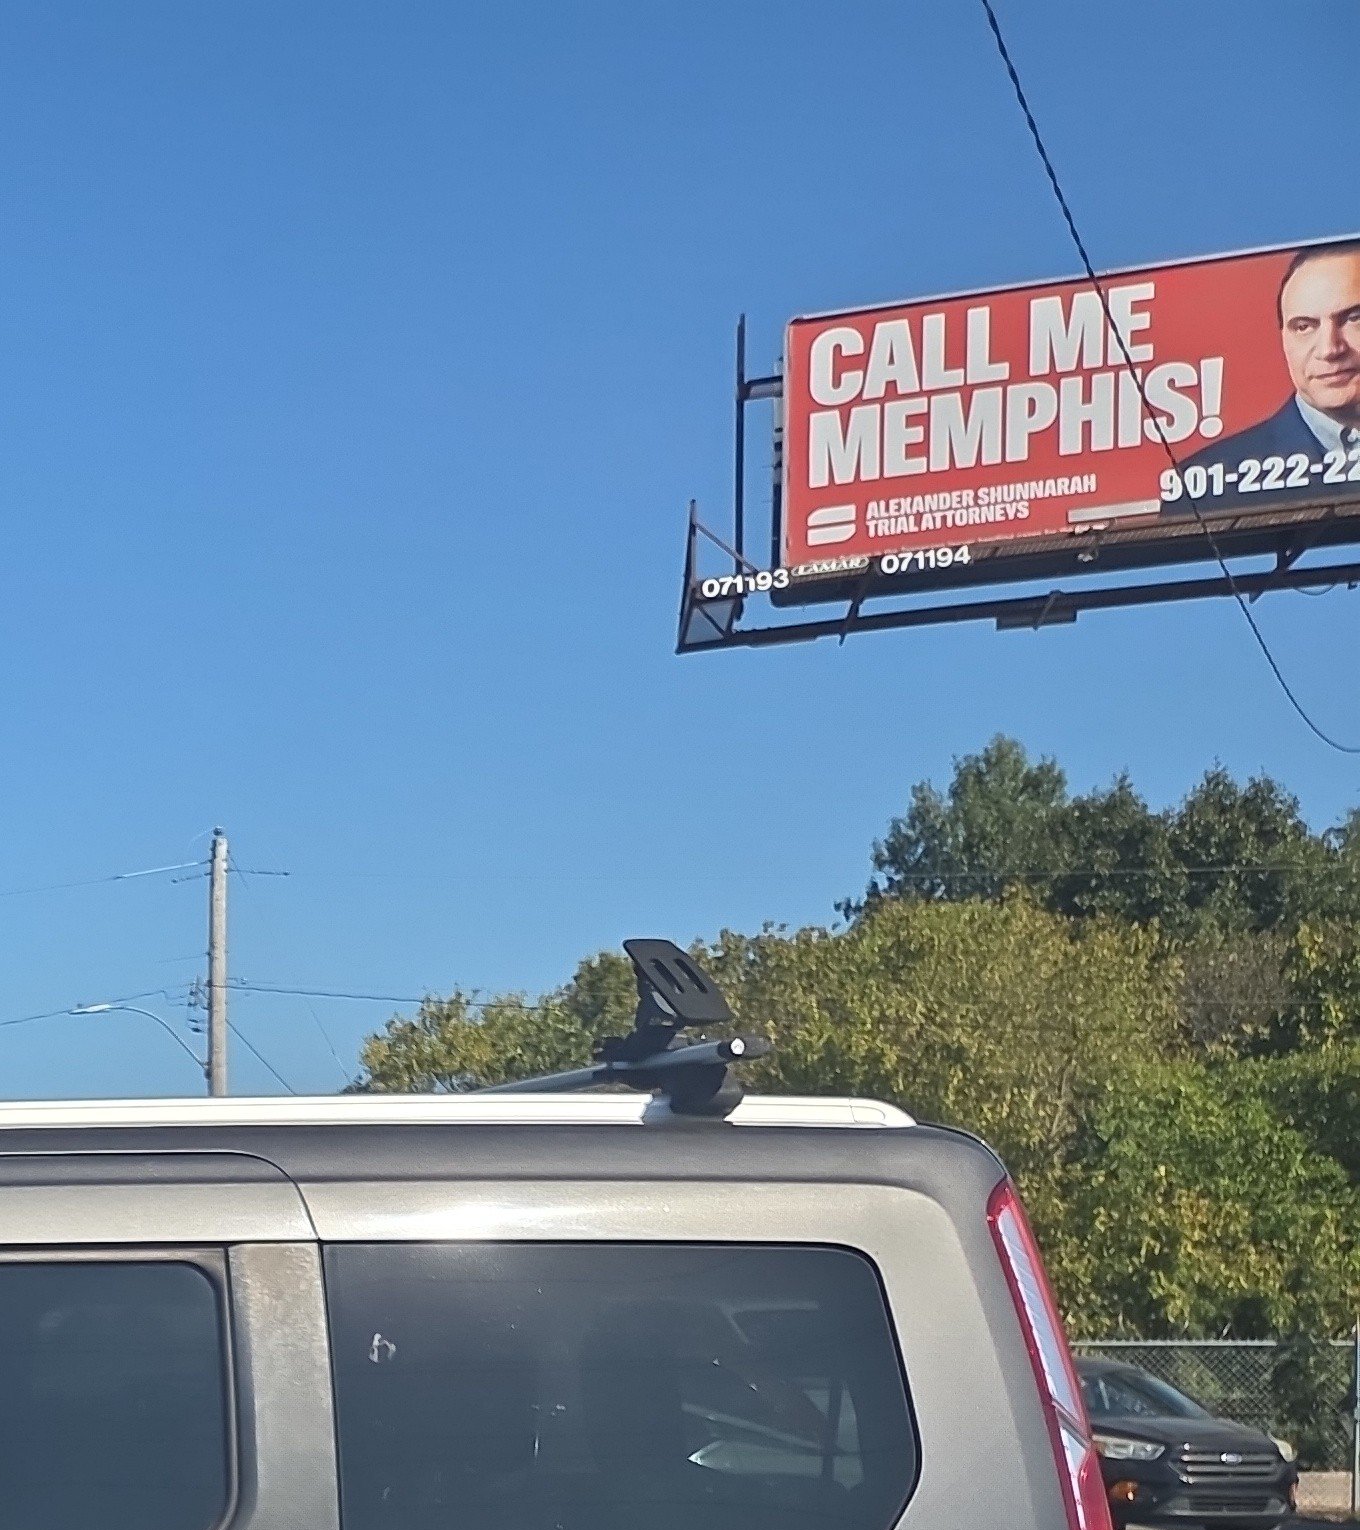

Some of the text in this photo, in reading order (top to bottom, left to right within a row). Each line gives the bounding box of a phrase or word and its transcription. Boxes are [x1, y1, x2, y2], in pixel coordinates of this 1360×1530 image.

[809, 281, 1155, 406] CALL ME
[809, 357, 1224, 489] MEMPHIS!
[866, 473, 1097, 520] ALEXANDER SHUNNARAH
[866, 501, 1029, 538] TRIAL ATTORNEYS
[794, 557, 864, 576] LAMAR
[880, 545, 971, 574] 071194
[701, 568, 790, 598] 071193
